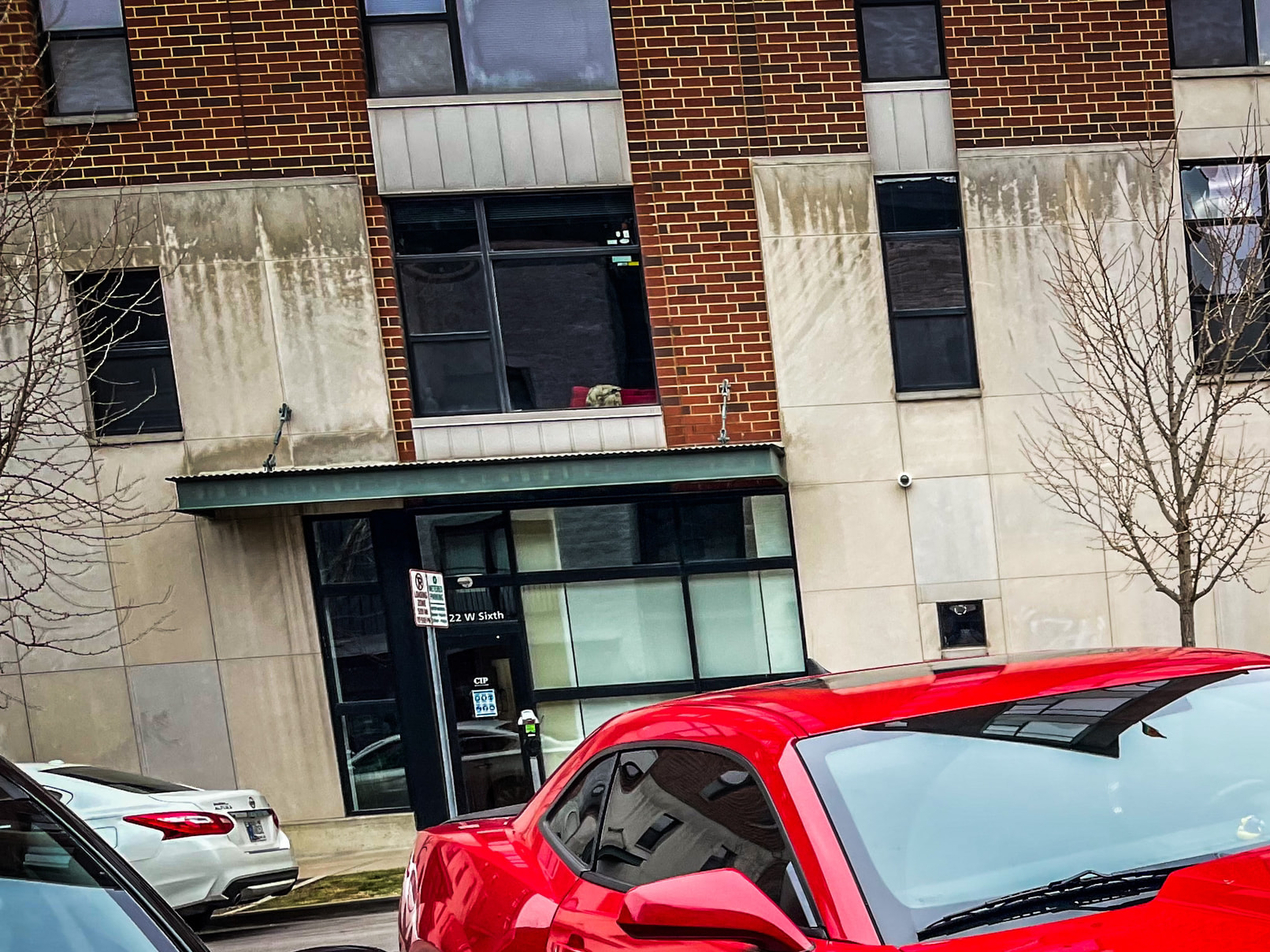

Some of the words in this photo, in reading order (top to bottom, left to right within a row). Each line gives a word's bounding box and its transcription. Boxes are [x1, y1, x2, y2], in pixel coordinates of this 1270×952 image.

[449, 614, 462, 623] 22
[464, 613, 476, 622] W
[478, 611, 504, 621] Sixth
